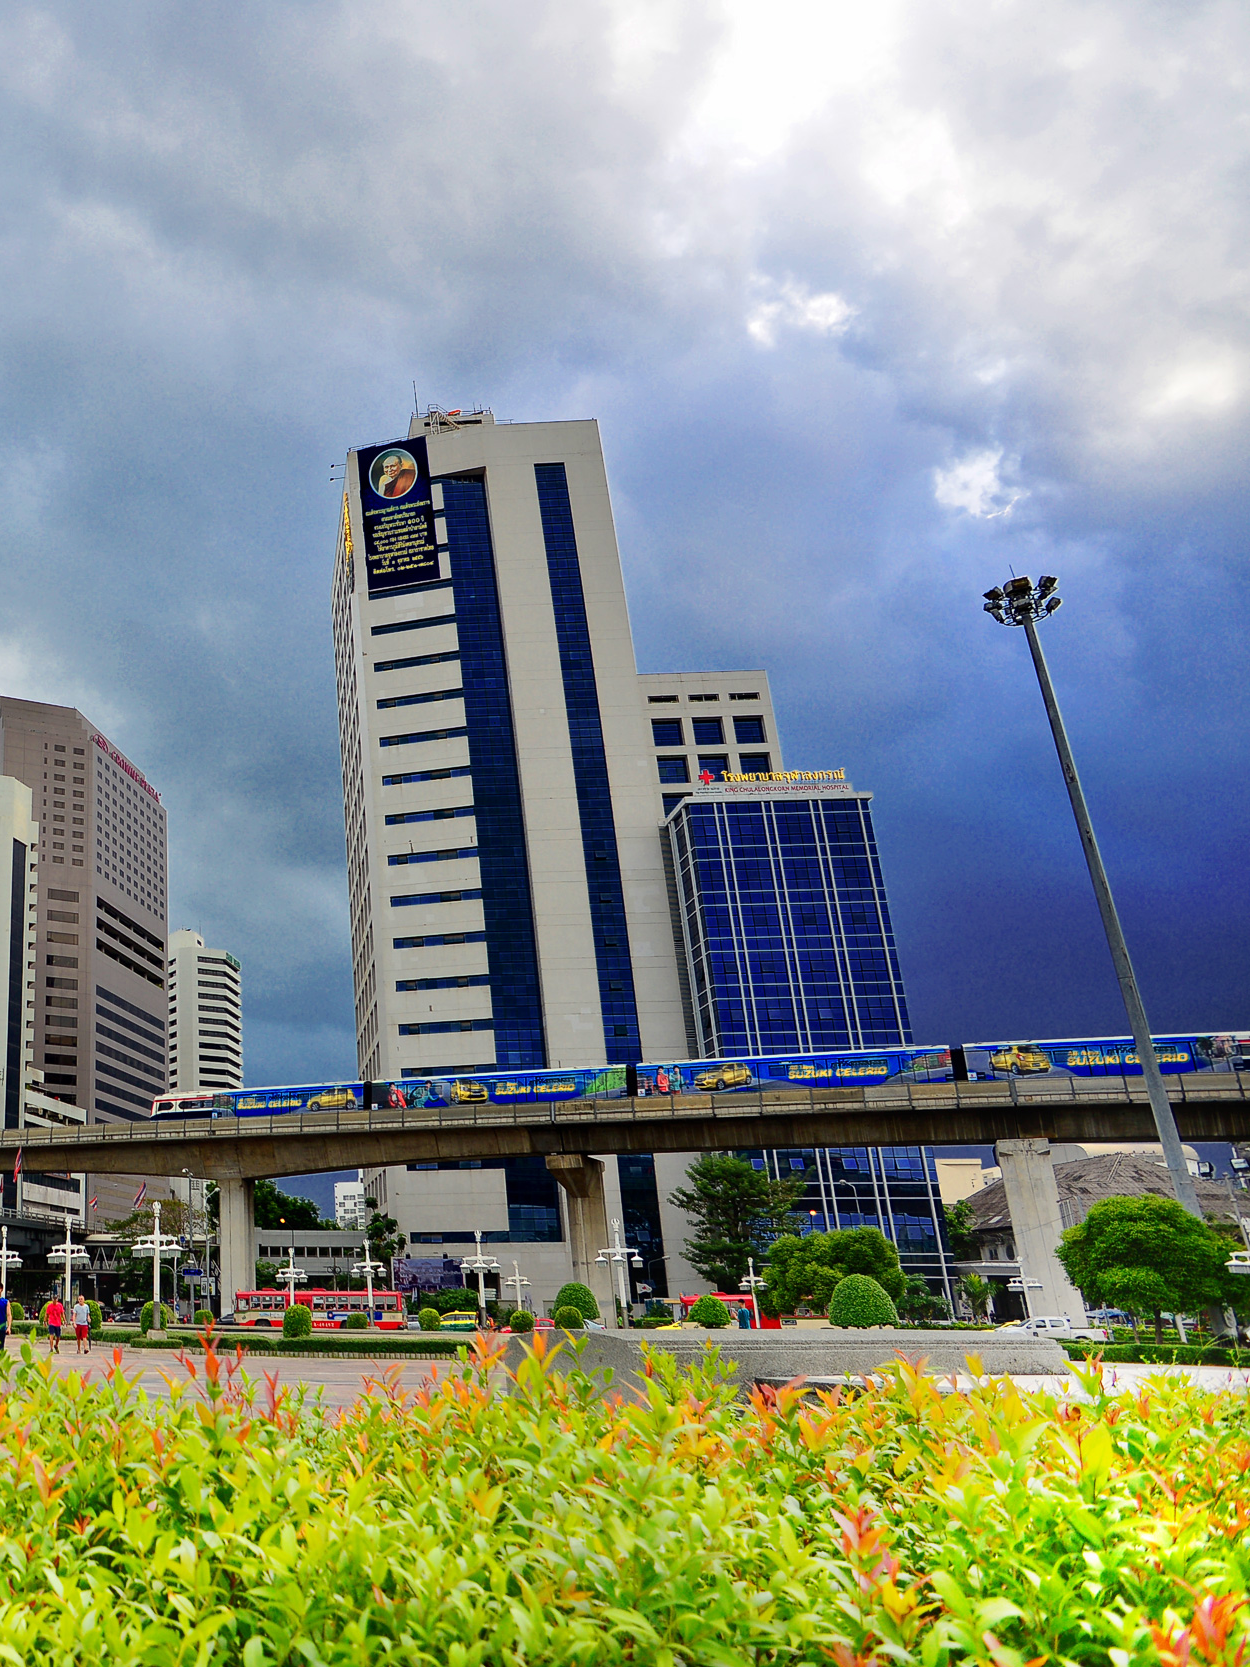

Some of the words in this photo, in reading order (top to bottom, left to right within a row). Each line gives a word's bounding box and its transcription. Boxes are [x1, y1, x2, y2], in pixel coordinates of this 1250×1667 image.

[111, 751, 139, 782] CROWNE
[721, 767, 845, 784] โรงพยาบาลจุฬาลงกรณ์
[1066, 1055, 1120, 1066] SUZUKI
[788, 1069, 832, 1080] SUZUKI
[835, 1066, 888, 1077] CELERIO
[495, 1086, 531, 1096] SUZUKI
[533, 1083, 575, 1093] CELERIO
[237, 1101, 266, 1109] SUZUKI
[268, 1098, 302, 1108] CELERIO
